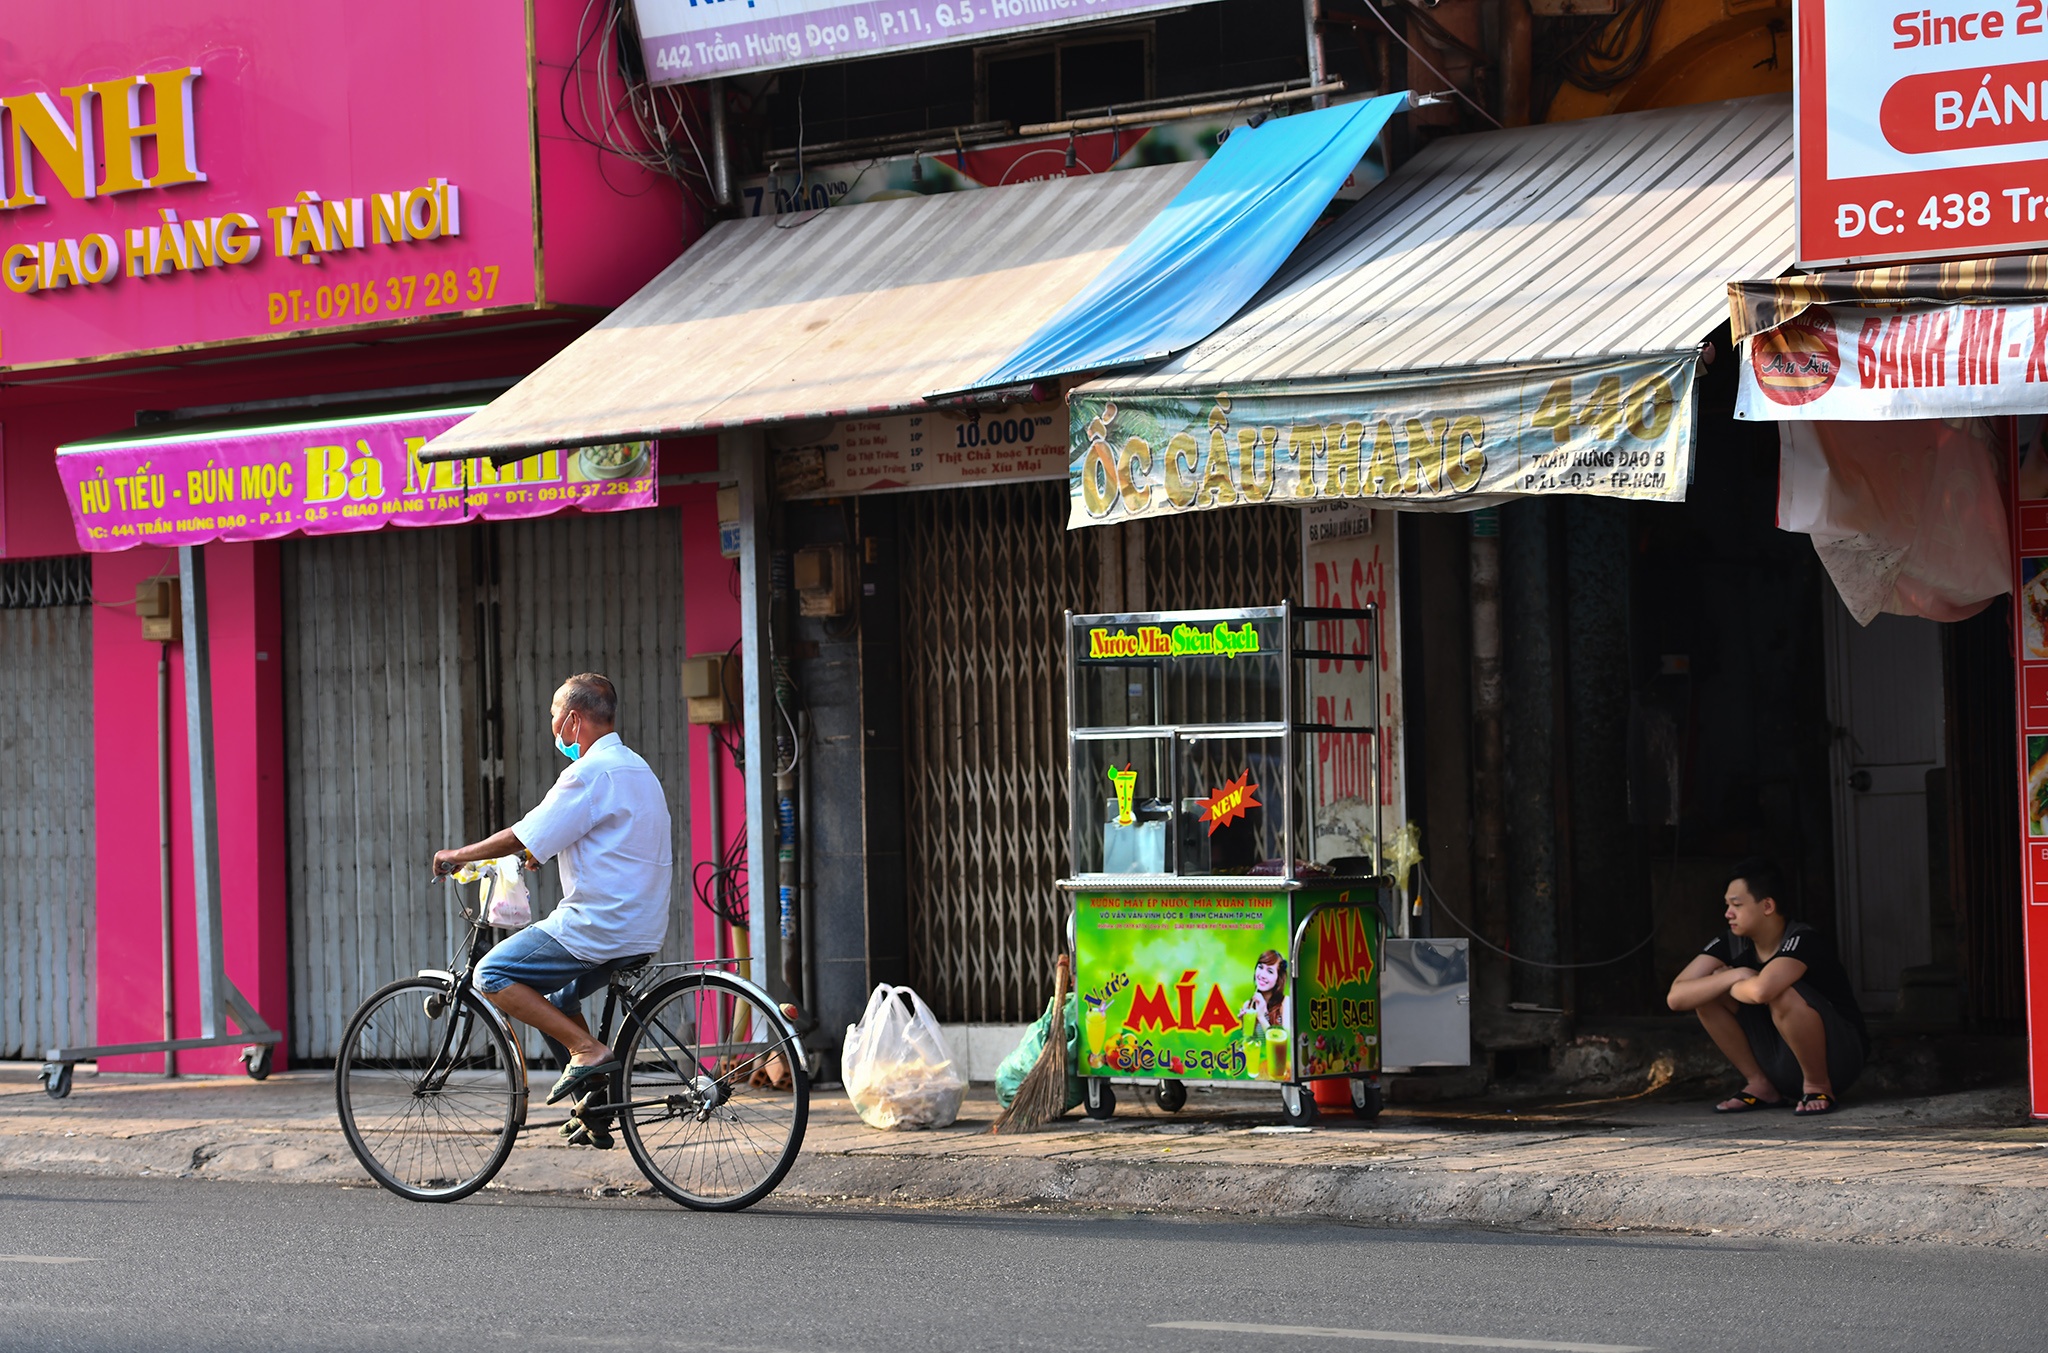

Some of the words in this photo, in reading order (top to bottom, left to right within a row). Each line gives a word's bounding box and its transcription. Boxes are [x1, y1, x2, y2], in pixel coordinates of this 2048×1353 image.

[656, 45, 693, 71] 442
[695, 32, 742, 65] Trần
[744, 30, 802, 58] Hưng
[805, 21, 849, 51] Đạo
[854, 16, 877, 42] B,
[935, 0, 975, 27] Q.5
[1893, 9, 2004, 50] Since
[2016, 0, 2048, 36] 2
[0, 67, 206, 209] NH
[2, 233, 119, 293] GIAO
[125, 208, 261, 277] HÀNG
[267, 190, 364, 264] TẬN
[371, 177, 460, 245] NƠI
[1834, 200, 1905, 239] ĐC:
[1917, 191, 1991, 231] 438
[268, 289, 310, 325] ĐT:
[316, 280, 378, 320] 0916
[385, 275, 417, 312] 37
[424, 270, 458, 307] 28
[466, 265, 500, 302] 37
[1761, 354, 1796, 374] An
[1530, 372, 1675, 444] 440
[936, 451, 962, 465] Thịt
[967, 447, 991, 462] Chả
[996, 449, 1022, 460] hoặc
[1025, 443, 1066, 457] Trứng
[956, 418, 1034, 448] 10.000
[1081, 402, 1152, 519] ỐC
[1164, 391, 1280, 509] CẦU
[1288, 415, 1488, 498] THANG
[79, 465, 111, 515] HỦ
[114, 461, 166, 511] TIẾU
[187, 459, 234, 505] BÚN
[241, 461, 294, 507] MỌC
[303, 438, 386, 505] Bà
[962, 465, 987, 477] hoặc
[1017, 459, 1042, 473] Mại
[1525, 473, 1555, 489] P.11
[1571, 473, 1596, 489] Q.5
[1611, 473, 1666, 489] TP.HCM
[1532, 447, 1569, 469] TRẦN
[1572, 449, 1615, 468] HƯNG
[1619, 451, 1650, 470] ĐẠO
[1654, 451, 1665, 467] B
[137, 517, 172, 535] TRẦN
[176, 515, 215, 532] HƯNG
[217, 511, 246, 530] ĐẠO
[259, 510, 292, 525] P.11
[305, 506, 329, 522] Q.5
[342, 503, 379, 518] GIAO
[382, 497, 424, 515] HÀNG
[427, 493, 460, 512] TẬN
[505, 490, 533, 503] ĐT:
[538, 479, 653, 502] 0916.37.28.37
[1309, 524, 1319, 541] 68
[1089, 628, 1138, 658] Nước
[1137, 626, 1172, 656] Mía
[1172, 622, 1213, 657] Siêu
[1213, 621, 1260, 659] Sạch
[1315, 560, 1343, 674] Bò
[1211, 785, 1244, 821] NEW
[1193, 896, 1213, 908] MÍA
[1246, 911, 1263, 919] HCM
[1316, 891, 1374, 993] MÍA
[1083, 972, 1130, 1012] Nước
[1122, 970, 1242, 1035] MÍA
[1117, 1039, 1173, 1069] siêu
[1184, 1041, 1247, 1077] sạch
